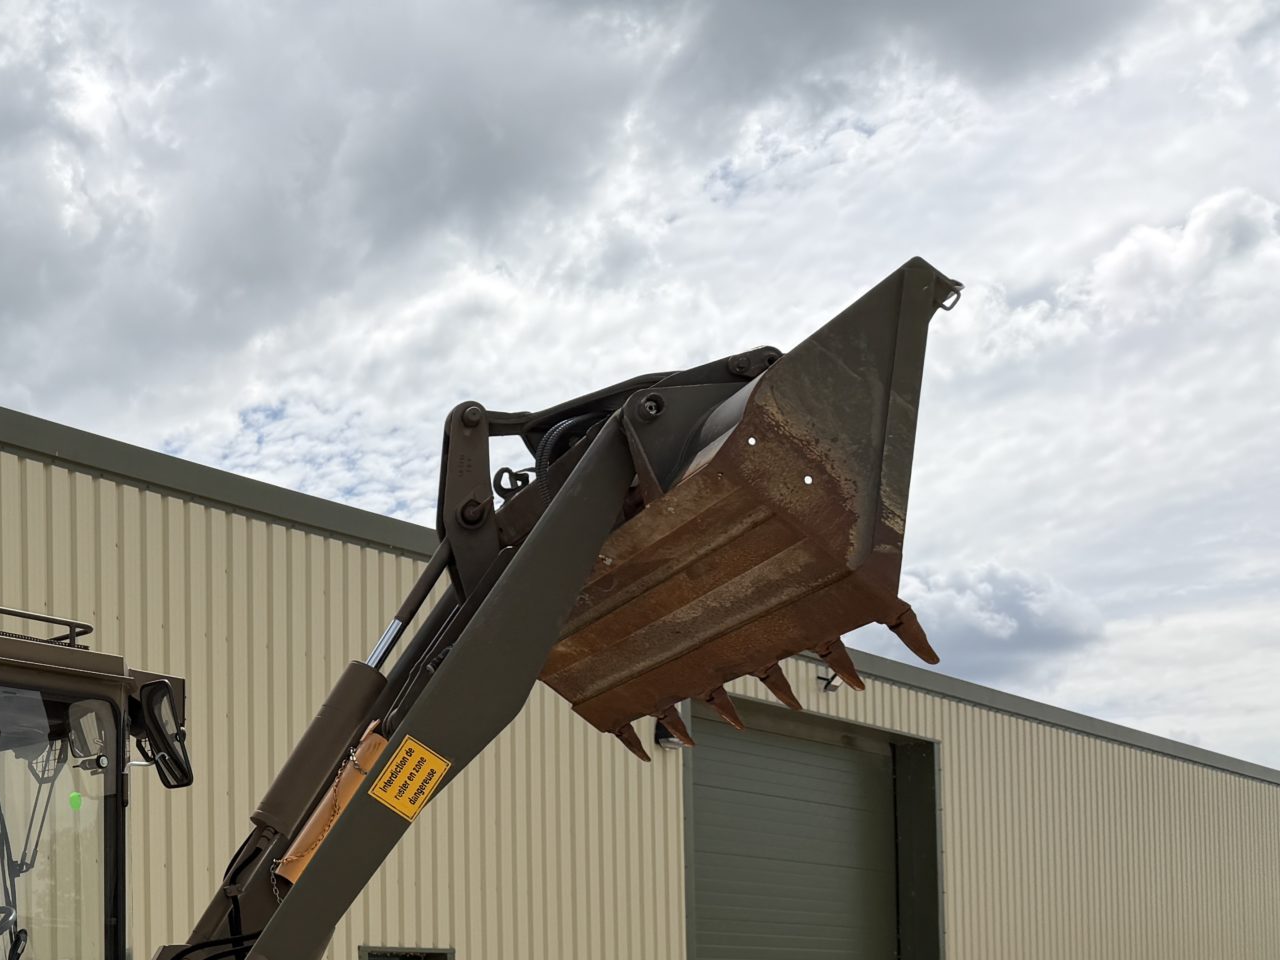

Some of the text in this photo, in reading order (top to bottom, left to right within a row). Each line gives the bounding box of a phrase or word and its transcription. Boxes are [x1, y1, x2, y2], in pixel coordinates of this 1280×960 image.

[379, 747, 415, 793] Interdiction de
[407, 771, 417, 782] en
[413, 756, 427, 773] zone
[408, 768, 437, 805] dangereuse
